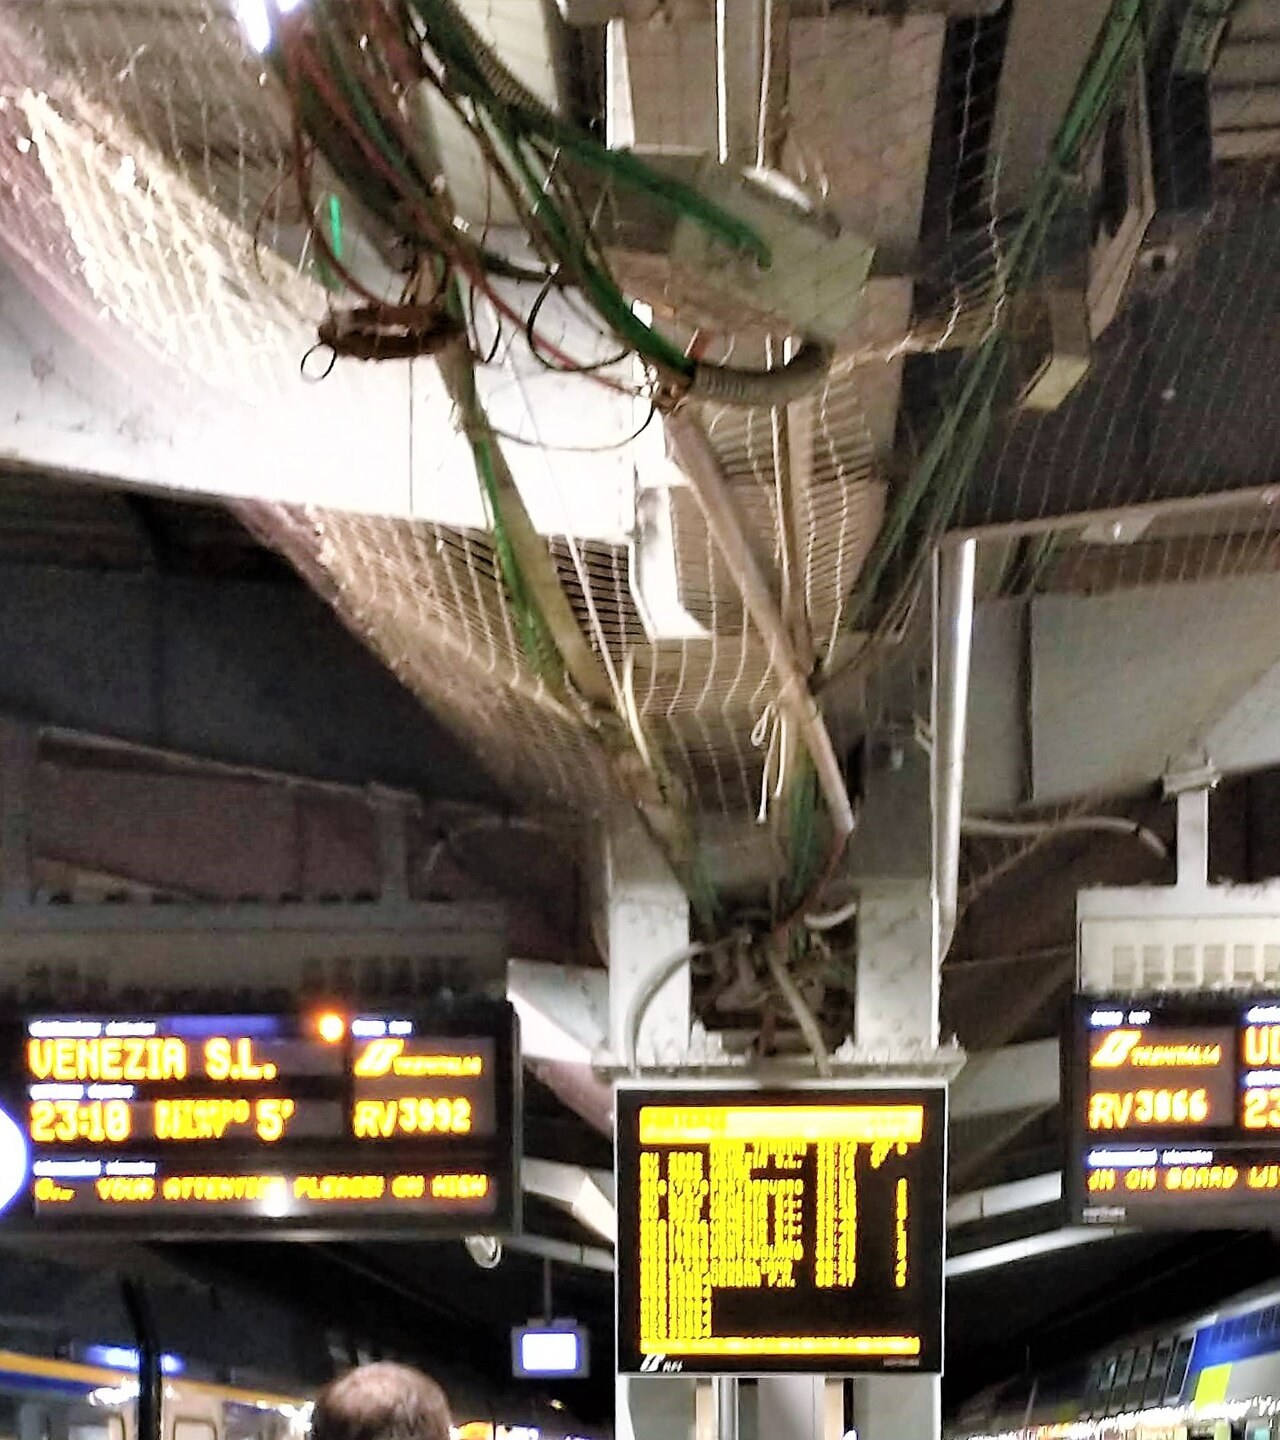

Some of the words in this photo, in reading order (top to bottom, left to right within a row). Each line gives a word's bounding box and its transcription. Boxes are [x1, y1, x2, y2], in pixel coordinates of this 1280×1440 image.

[28, 1037, 188, 1081] VENEZIA
[204, 1037, 277, 1081] S.L.
[30, 1099, 131, 1142] 23:10
